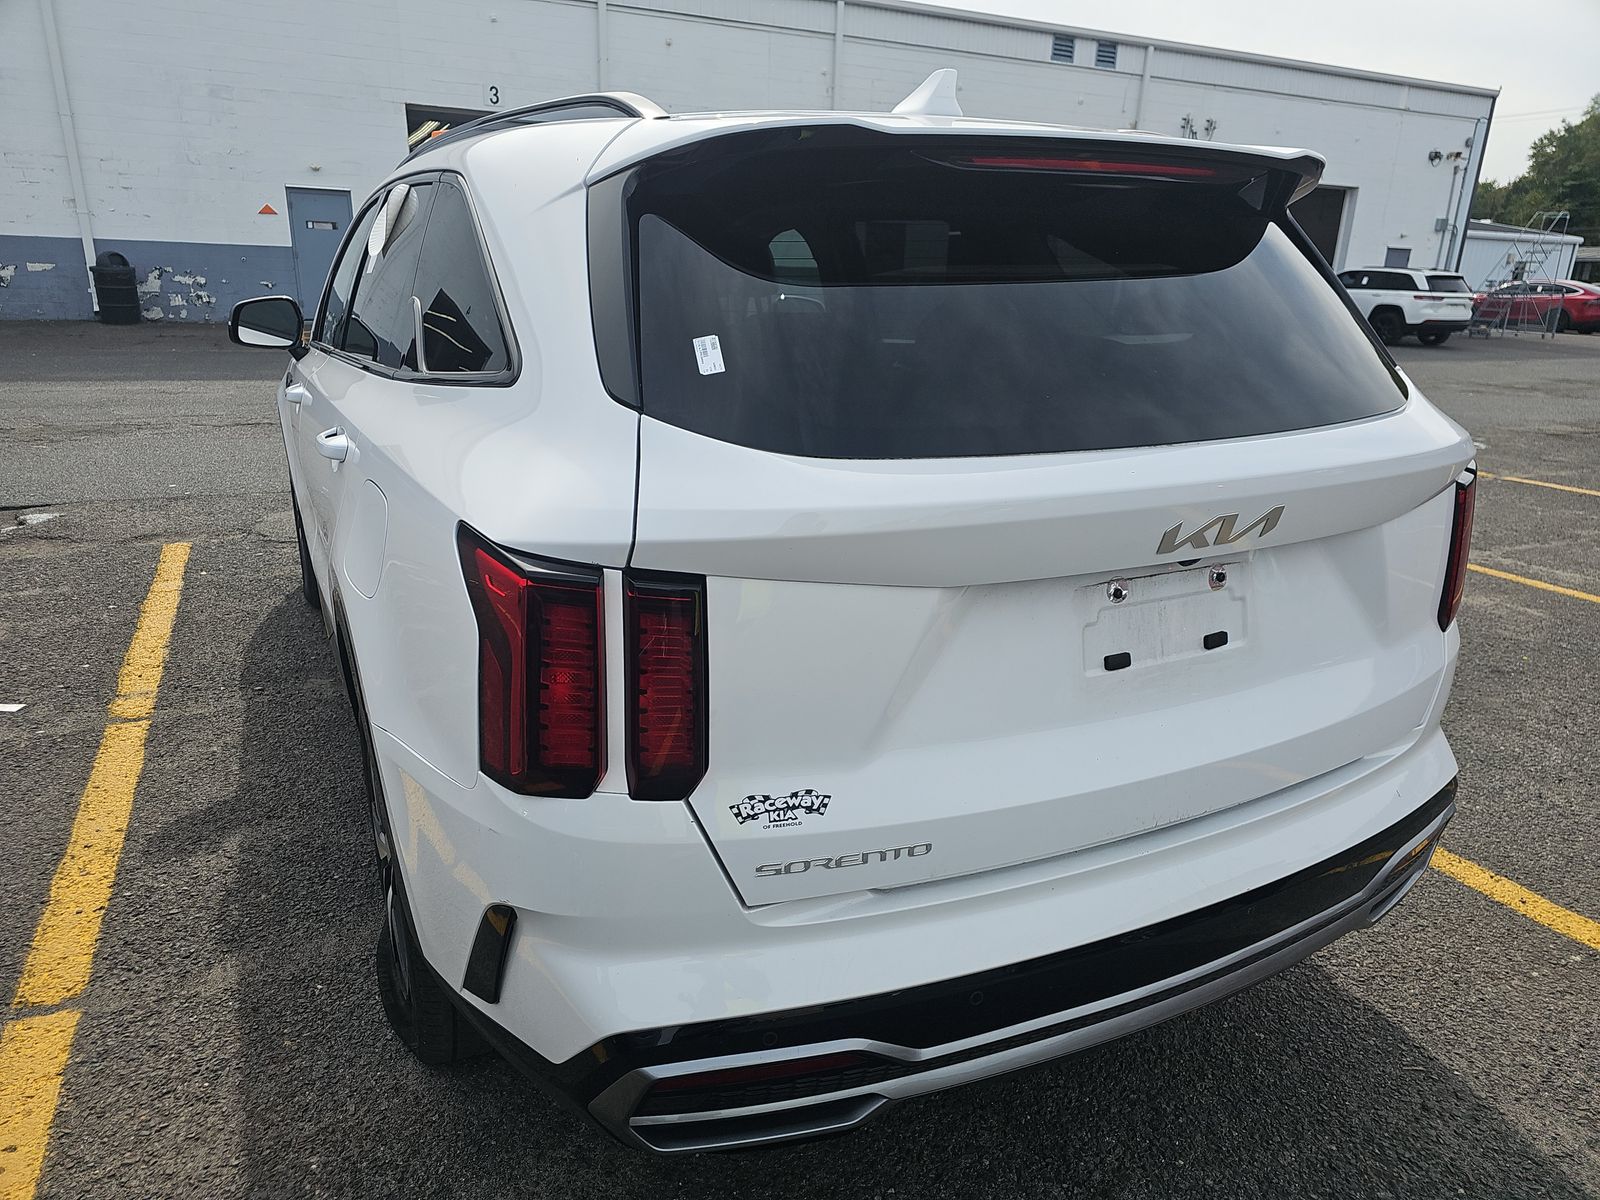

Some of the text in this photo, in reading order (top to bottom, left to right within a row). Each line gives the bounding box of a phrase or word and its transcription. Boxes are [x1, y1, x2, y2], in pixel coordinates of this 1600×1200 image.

[489, 85, 500, 105] 3
[738, 794, 824, 818] Raceway
[768, 809, 798, 822] KIA
[772, 821, 803, 829] FREEHOLD
[755, 841, 933, 877] SORENTO
